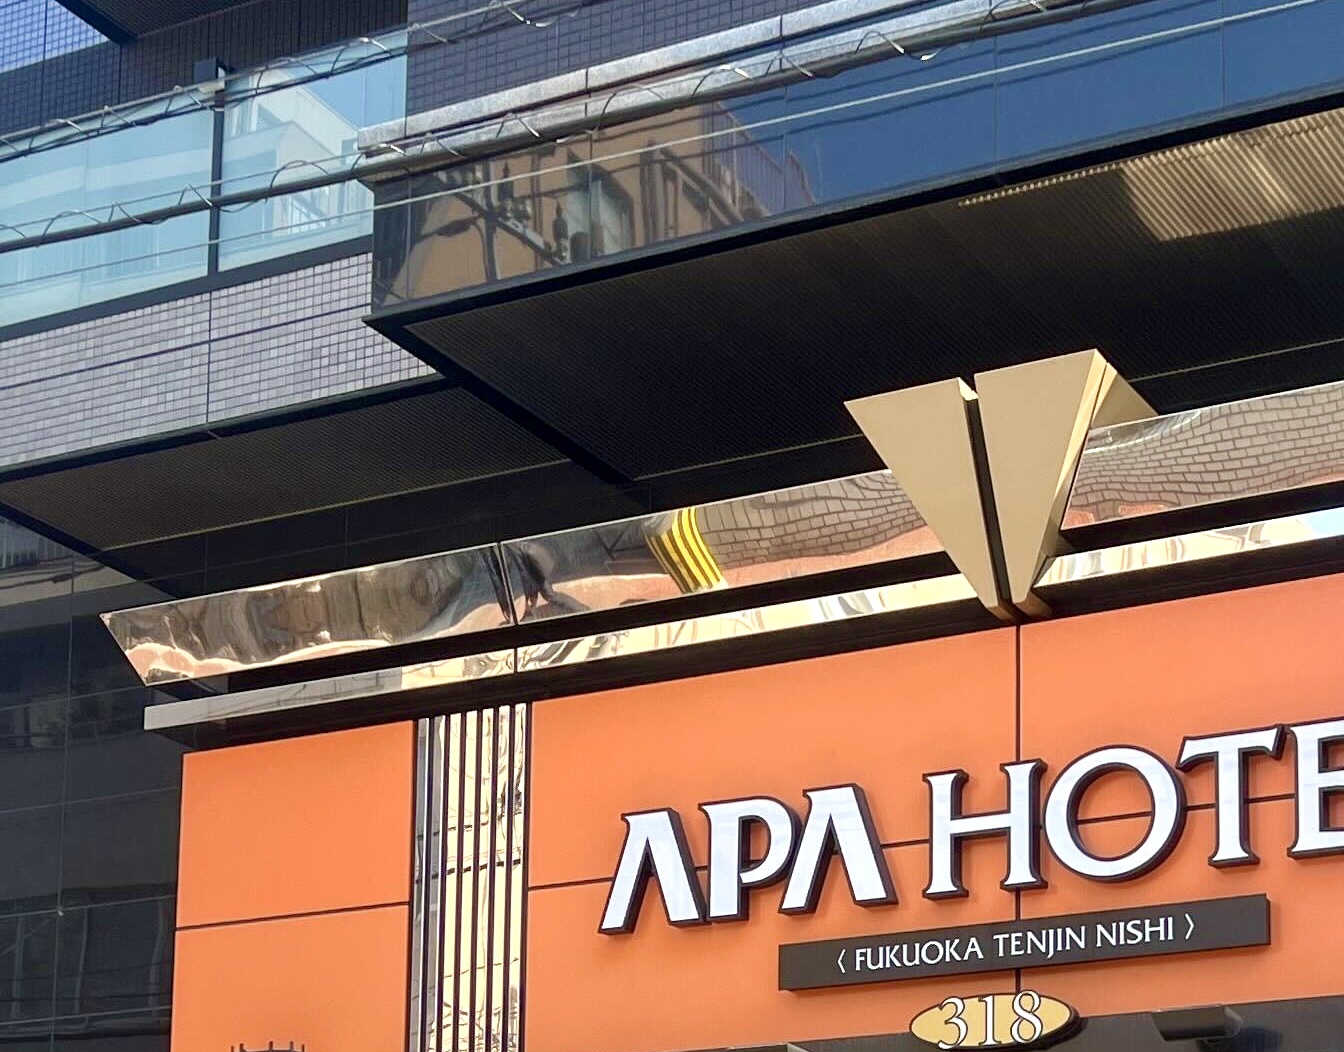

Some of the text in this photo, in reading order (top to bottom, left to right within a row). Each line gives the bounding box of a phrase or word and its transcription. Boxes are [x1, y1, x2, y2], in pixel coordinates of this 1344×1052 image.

[598, 783, 899, 935] APA
[855, 937, 984, 971] FUKUOKA
[993, 925, 1086, 958] TENJIN
[1096, 917, 1173, 947] NISHI
[938, 990, 1042, 1050] 318
